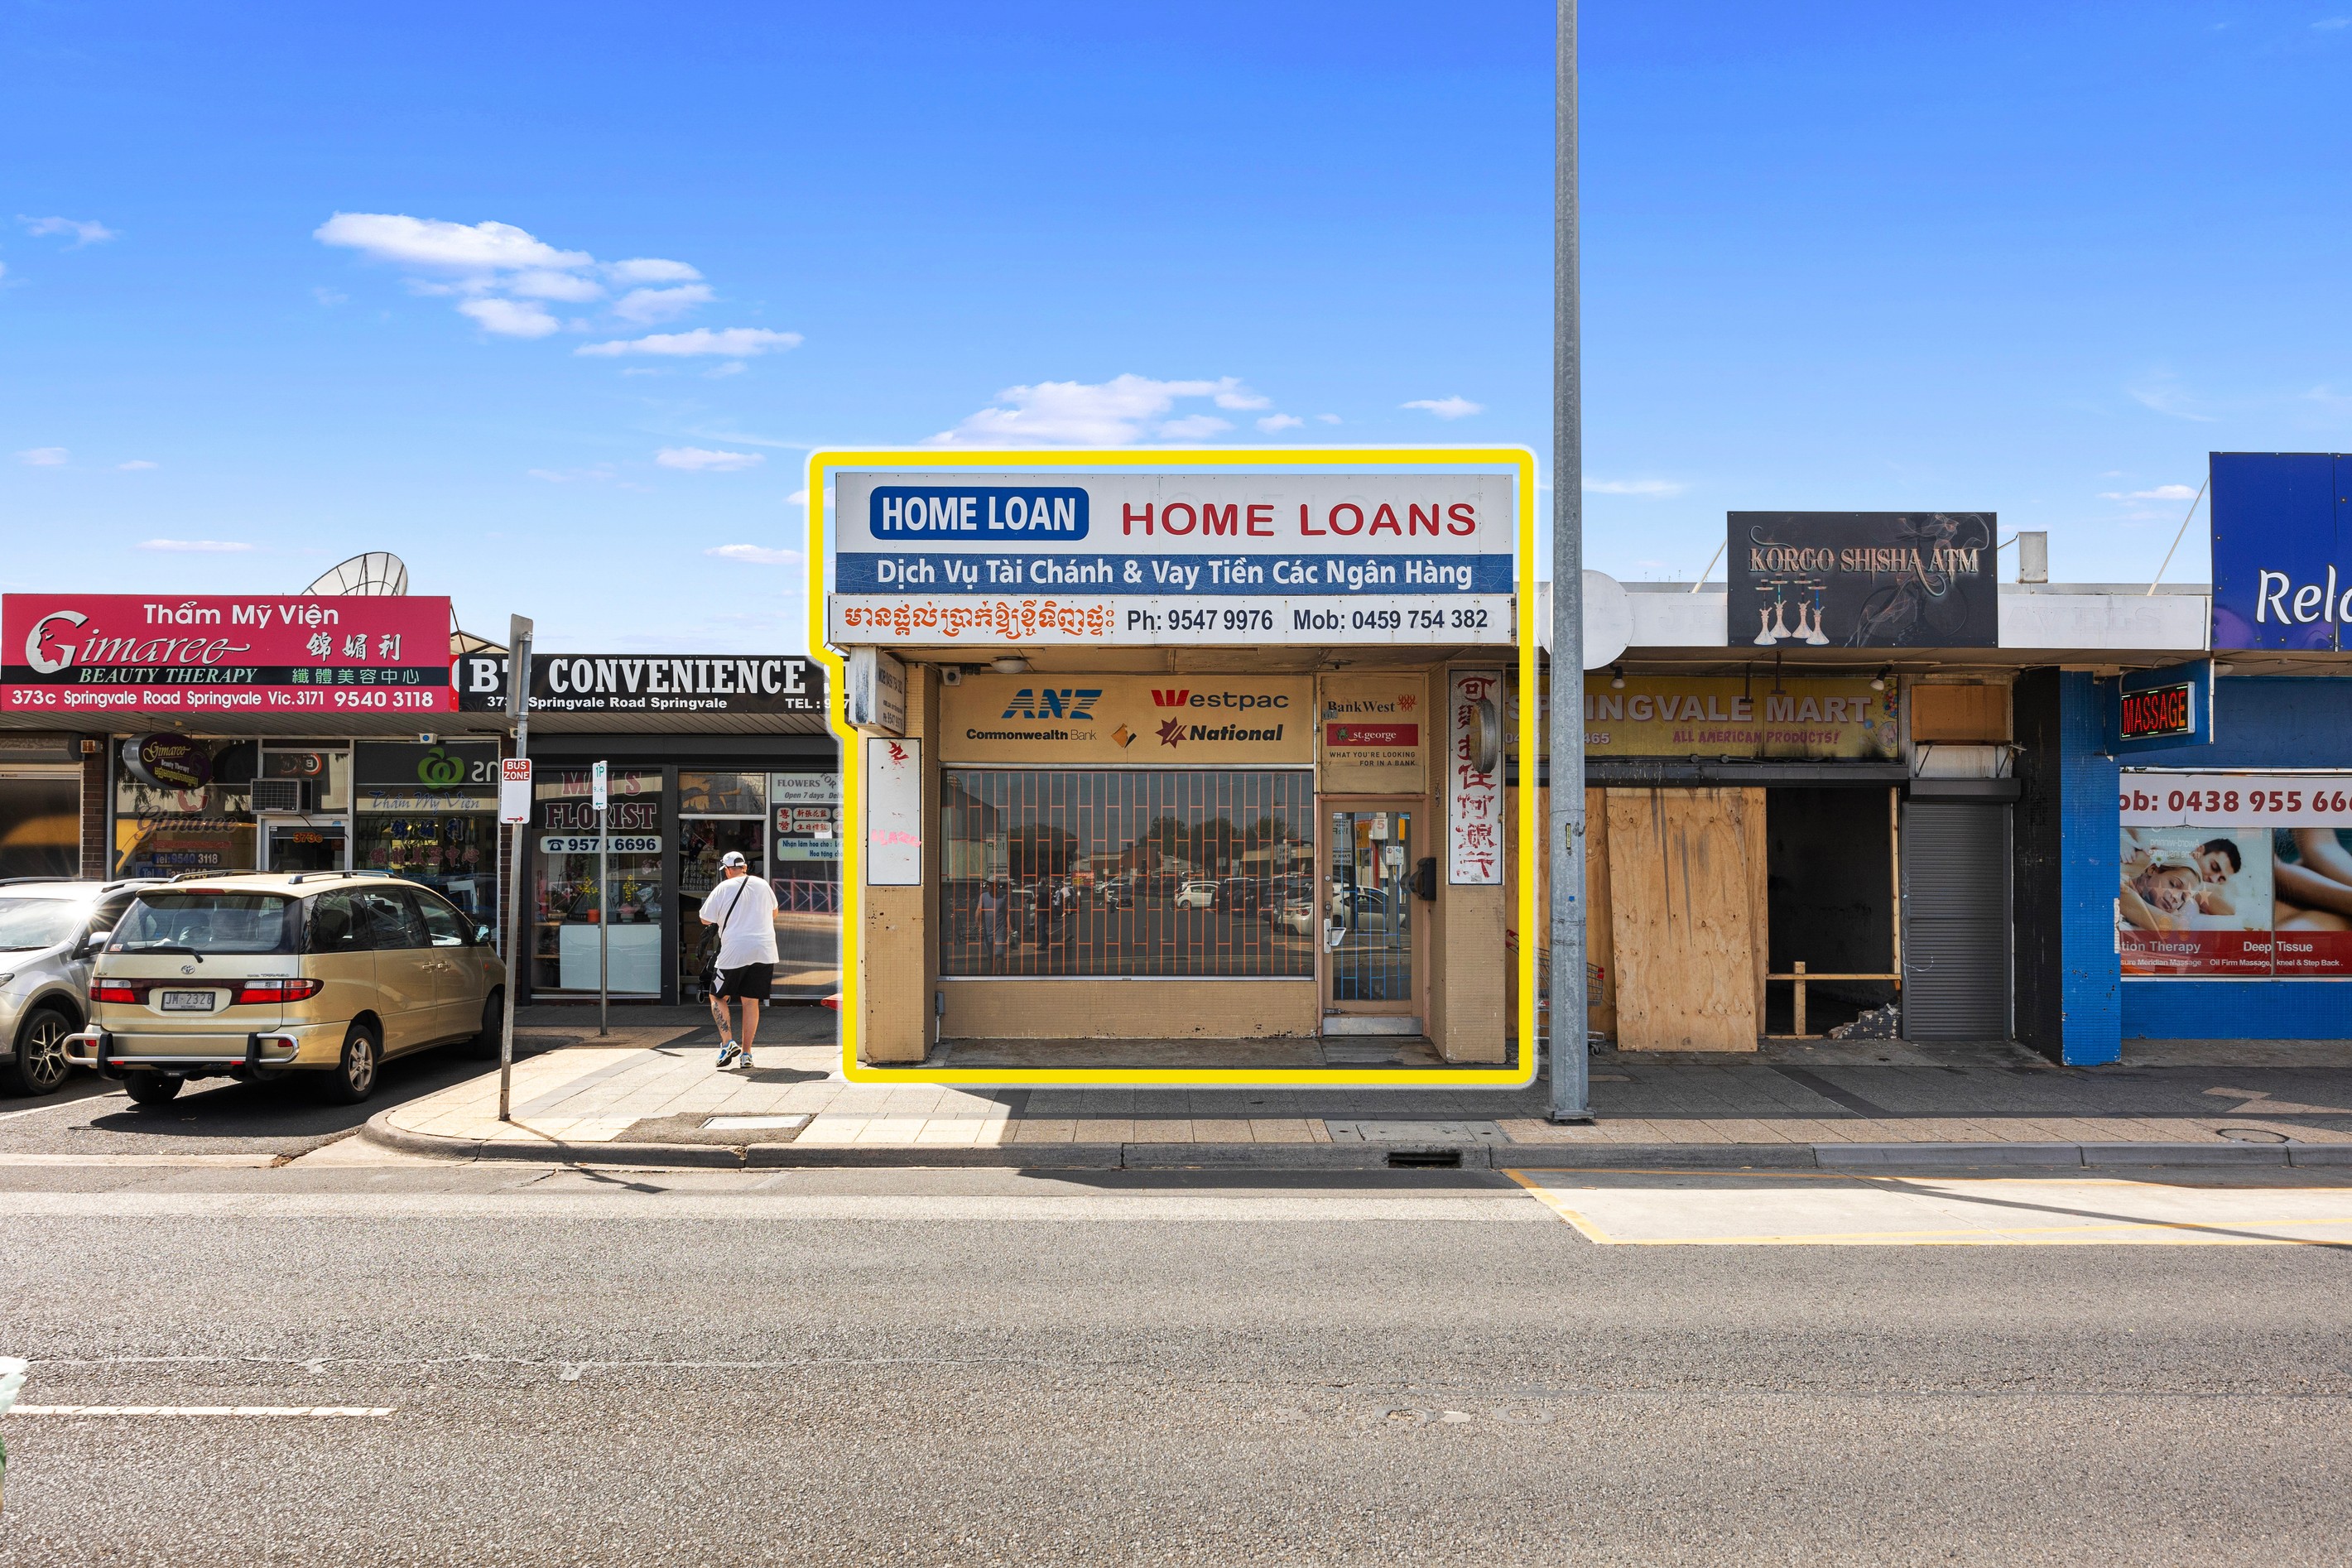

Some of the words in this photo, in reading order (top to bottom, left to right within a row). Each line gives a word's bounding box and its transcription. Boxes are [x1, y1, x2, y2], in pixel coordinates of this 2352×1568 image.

[883, 497, 977, 531] HOME
[988, 497, 1075, 531] LOAN
[1123, 503, 1275, 536] HOME
[1300, 503, 1476, 537] LOANS
[878, 559, 935, 589] Dịch
[944, 560, 979, 589] Vụ
[985, 559, 1022, 583] Tài
[1030, 559, 1113, 583] Chánh
[1123, 560, 1142, 584] &
[1152, 560, 1200, 590] Vay
[1208, 557, 1263, 584] Tiền
[1272, 558, 1318, 584] Các
[1326, 560, 1396, 590] Ngân
[1405, 560, 1472, 590] Hàng
[1749, 548, 1834, 573] KORGO
[1840, 548, 1946, 586] SHISHA
[1928, 548, 1979, 578] ATM
[144, 601, 220, 625] Thẩm
[232, 604, 273, 628] Mỹ
[281, 604, 339, 628] Viện
[1127, 610, 1162, 631] Ph:
[1168, 609, 1217, 631] 9547
[1224, 609, 1273, 631] 9976
[1294, 610, 1345, 630] Mob:
[1352, 609, 1401, 630] 0459
[1408, 609, 1445, 629] 754
[1450, 608, 1488, 628] 382
[26, 610, 251, 674] Gimaree
[79, 668, 162, 684] BEAUTY
[166, 668, 257, 684] THERAPY
[549, 659, 806, 694] CONVENIENCE
[12, 690, 56, 705] 373c
[64, 690, 137, 709] Springvale
[143, 690, 180, 706] Road
[186, 691, 262, 709] Springvale
[334, 691, 386, 707] 9540
[392, 691, 433, 707] 3118
[528, 696, 605, 710] Springvale
[610, 697, 645, 708] Road
[651, 697, 728, 710] Springvale
[1001, 689, 1103, 720] ANZ
[1151, 690, 1289, 711] Westpac
[1327, 701, 1395, 713] BankWest
[1507, 695, 1753, 722] SPINGVALE
[1766, 696, 1873, 723] MART
[2124, 690, 2186, 734] MASSAGE
[966, 729, 1068, 740] Commonwealth
[1070, 729, 1097, 740] Bank
[1190, 724, 1283, 741] National
[1353, 732, 1397, 742] st.george
[1672, 729, 1695, 743] ALL
[1698, 728, 1763, 743] AMERICAN
[1765, 728, 1841, 744] PRODUCTS!
[142, 742, 191, 762] Gimaree
[507, 761, 527, 770] BUS
[595, 766, 604, 777] 1P
[503, 772, 530, 780] ZONE
[777, 779, 820, 787] FLOWERS
[820, 772, 837, 789] FOR
[2119, 790, 2159, 811] ob:
[2167, 791, 2239, 812] 0438
[2249, 791, 2302, 812] 955
[2311, 791, 2352, 812] 66
[546, 802, 657, 830] FLORIST
[292, 832, 323, 843] 373c
[614, 838, 657, 851] 6696
[809, 839, 819, 848] hoa
[171, 854, 196, 863] 9540
[198, 854, 219, 864] 3118
[2149, 940, 2201, 954] Therapy
[2243, 941, 2272, 954] Deep
[2276, 940, 2313, 952] Tissue
[2169, 959, 2202, 967] Massage
[2239, 959, 2272, 968] Massage,
